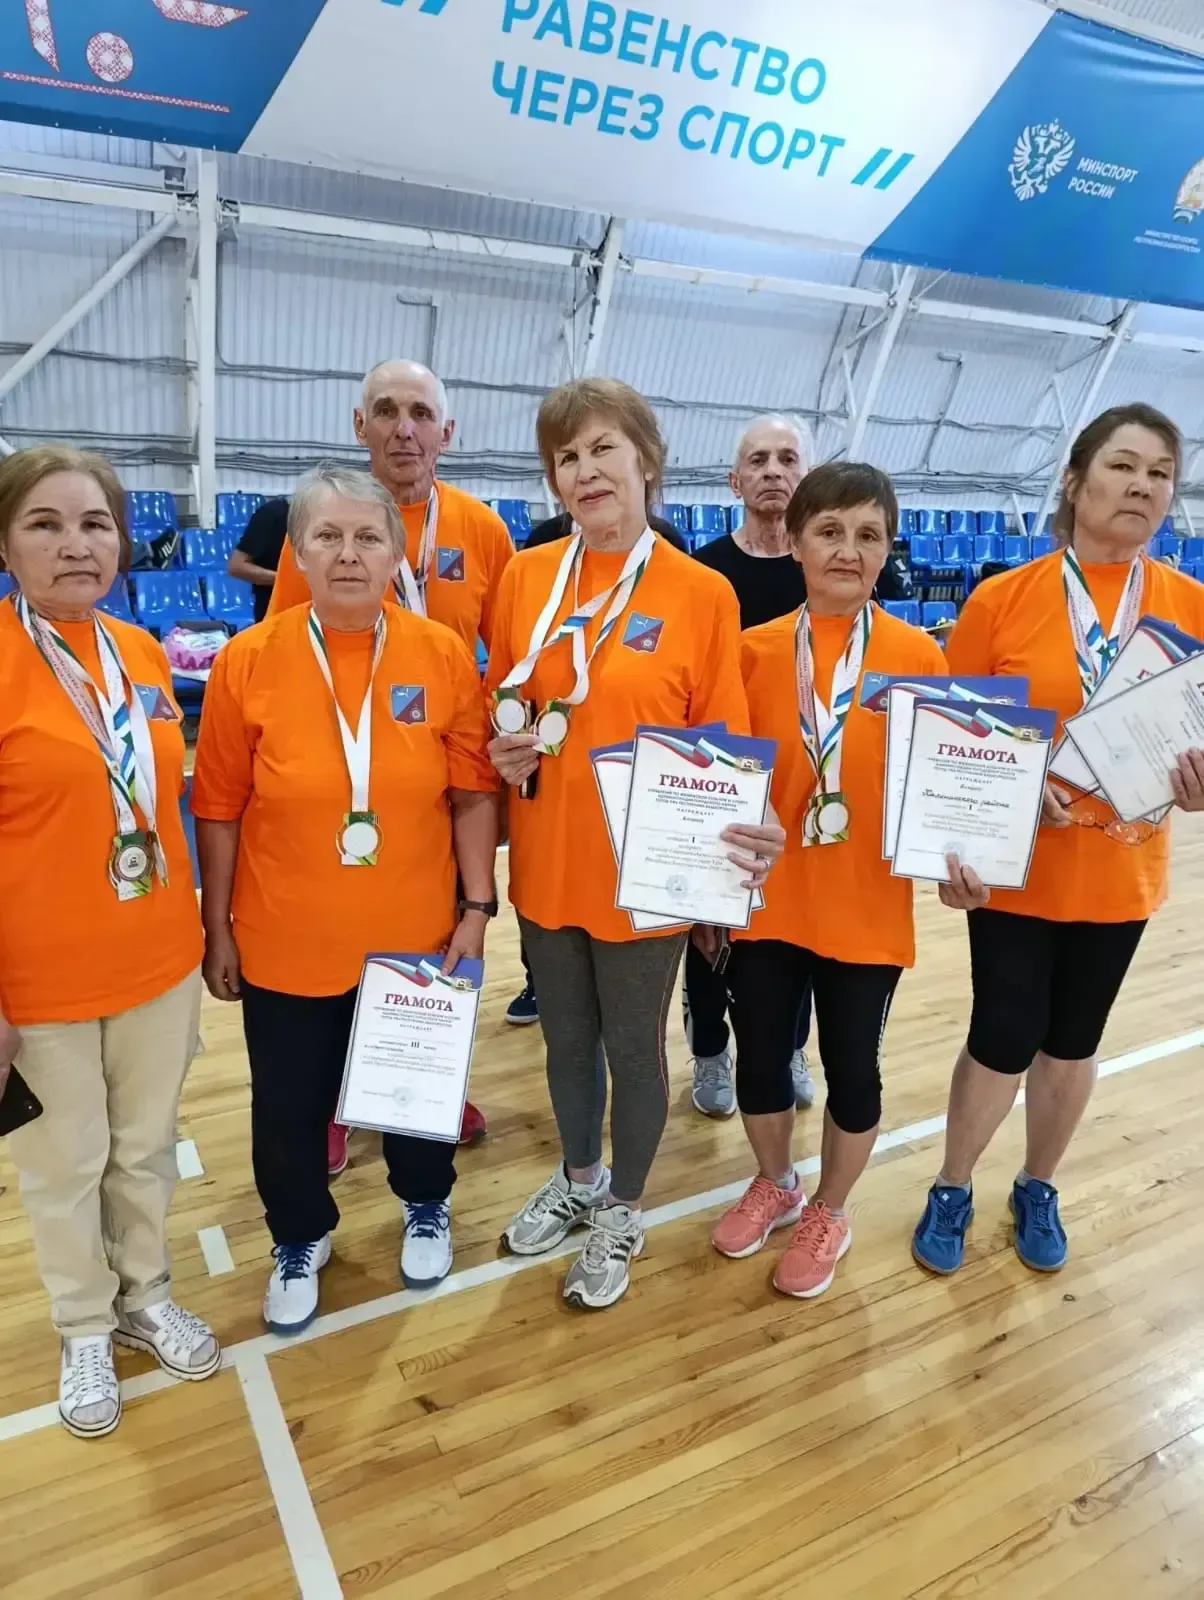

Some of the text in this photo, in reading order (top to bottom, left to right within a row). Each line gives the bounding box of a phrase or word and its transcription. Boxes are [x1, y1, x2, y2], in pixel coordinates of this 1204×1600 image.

[501, 0, 827, 104] РАВЕНСТВО
[492, 60, 846, 177] ЧЕРЕЗ СПОРТ
[1076, 157, 1139, 183] МИНСПОРТ
[1067, 177, 1117, 199] РОССИИ
[937, 743, 1018, 764] ГРАМОТА
[659, 774, 739, 795] ГРАМОТА
[384, 993, 454, 1012] ГРАМОТА
